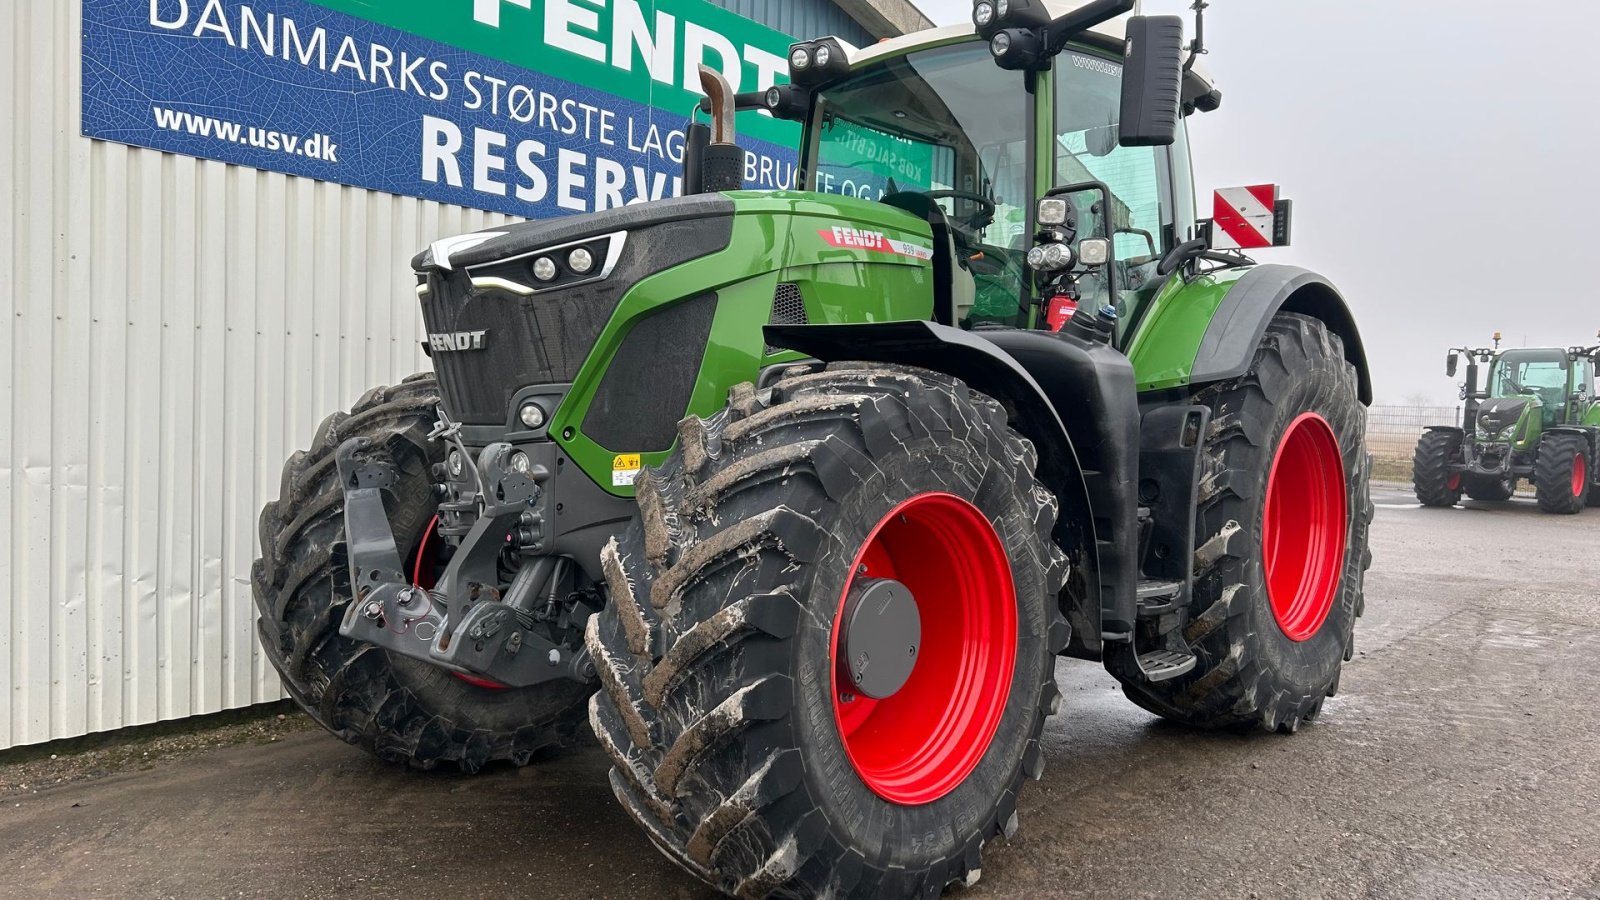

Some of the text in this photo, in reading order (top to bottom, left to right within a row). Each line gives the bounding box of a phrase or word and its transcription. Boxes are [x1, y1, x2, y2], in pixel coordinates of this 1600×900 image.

[1072, 55, 1122, 77] www.usv
[150, 0, 448, 100] DANMARKS
[463, 71, 614, 145] STØRSTE
[628, 117, 684, 163] LAG
[154, 107, 337, 162] www.usv.dk
[832, 226, 883, 248] FENDT
[903, 243, 914, 254] 939
[429, 331, 487, 352] FENDT
